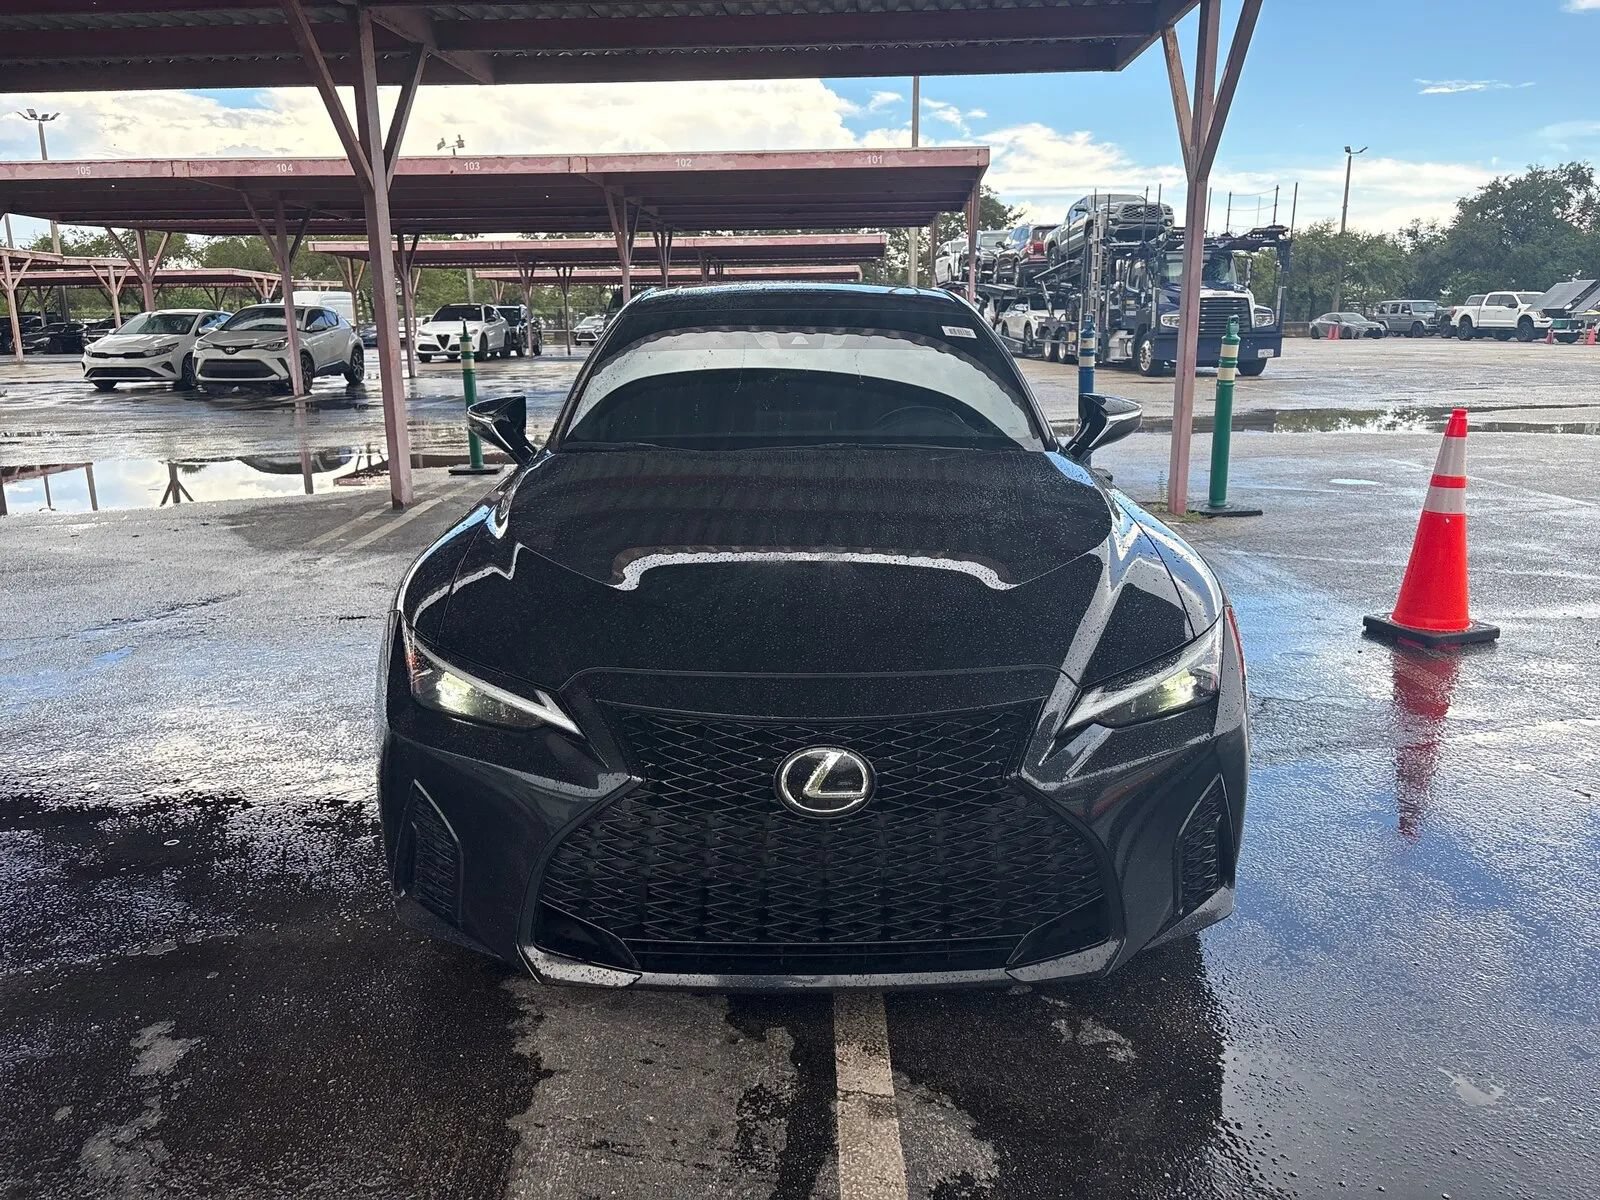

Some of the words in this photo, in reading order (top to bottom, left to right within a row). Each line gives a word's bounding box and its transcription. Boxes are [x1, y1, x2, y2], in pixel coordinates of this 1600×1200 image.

[675, 158, 692, 168] 102
[866, 155, 883, 165] 101
[75, 166, 91, 176] 105
[276, 163, 294, 173] 104
[463, 161, 480, 171] 103
